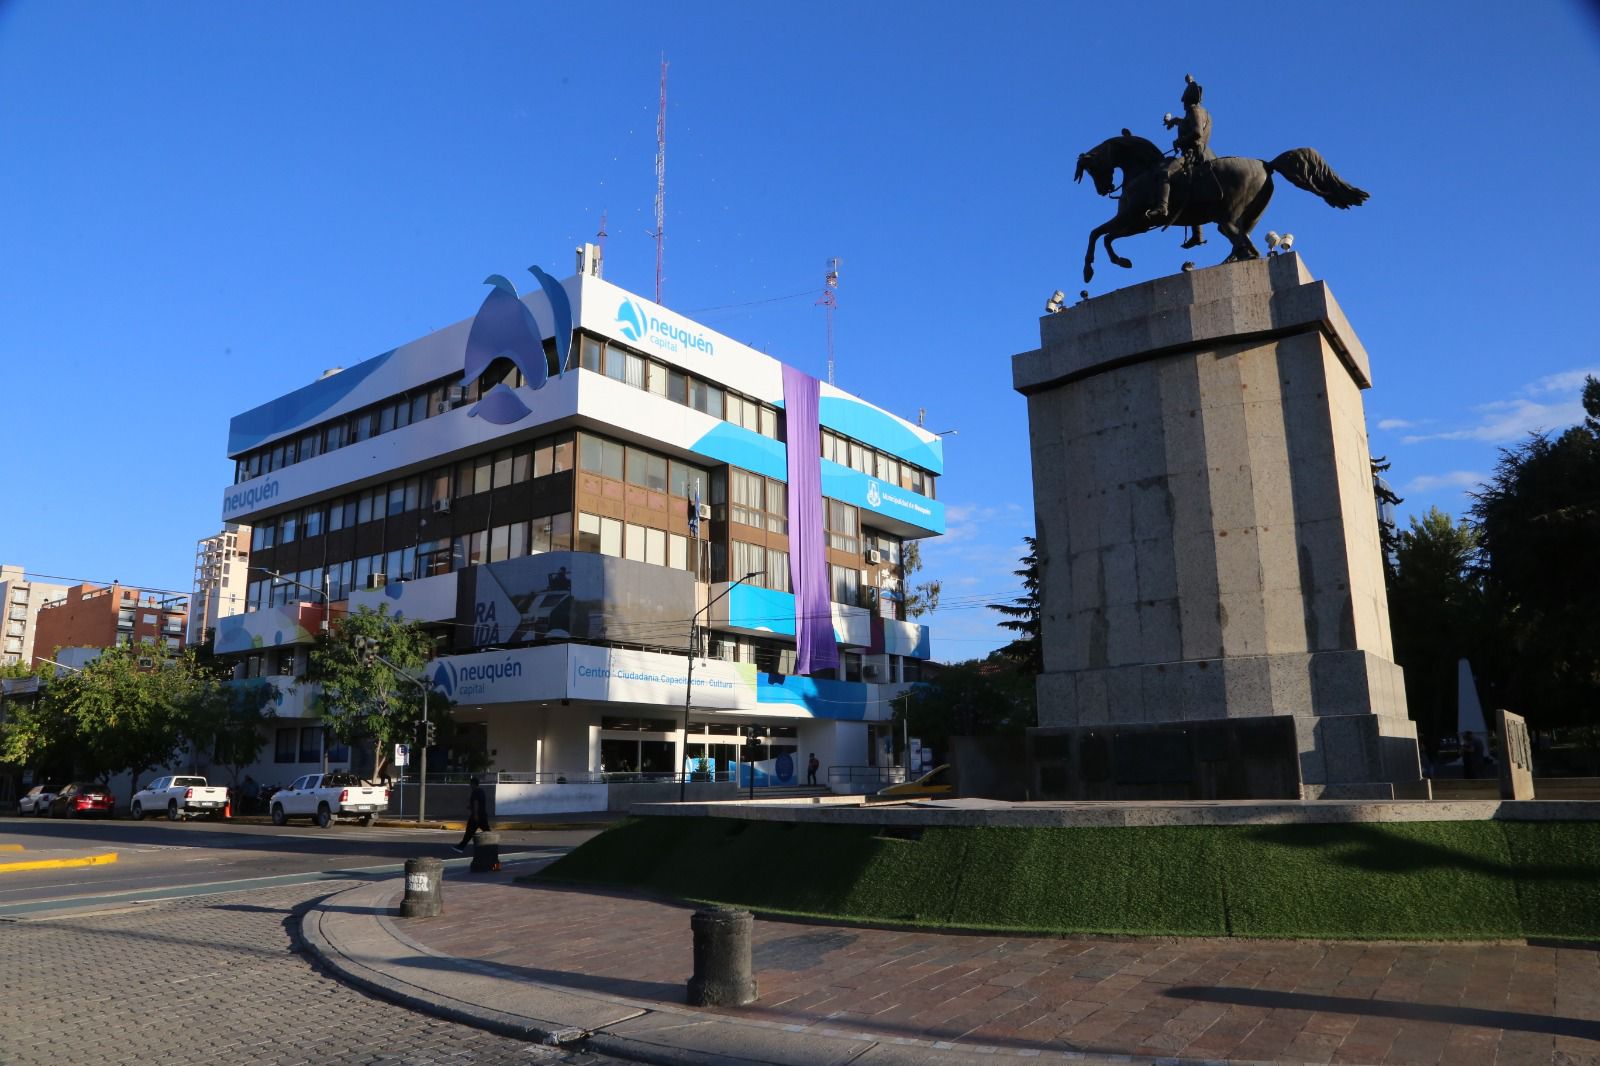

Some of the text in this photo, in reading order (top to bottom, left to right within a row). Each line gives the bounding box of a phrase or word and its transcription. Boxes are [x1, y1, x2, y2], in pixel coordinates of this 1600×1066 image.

[650, 317, 713, 355] neuquén
[650, 335, 678, 352] capital
[223, 477, 279, 513] neuquén
[460, 656, 522, 684] neuquén
[578, 665, 610, 678] Centro
[709, 678, 734, 689] Cultura
[460, 683, 485, 697] capital
